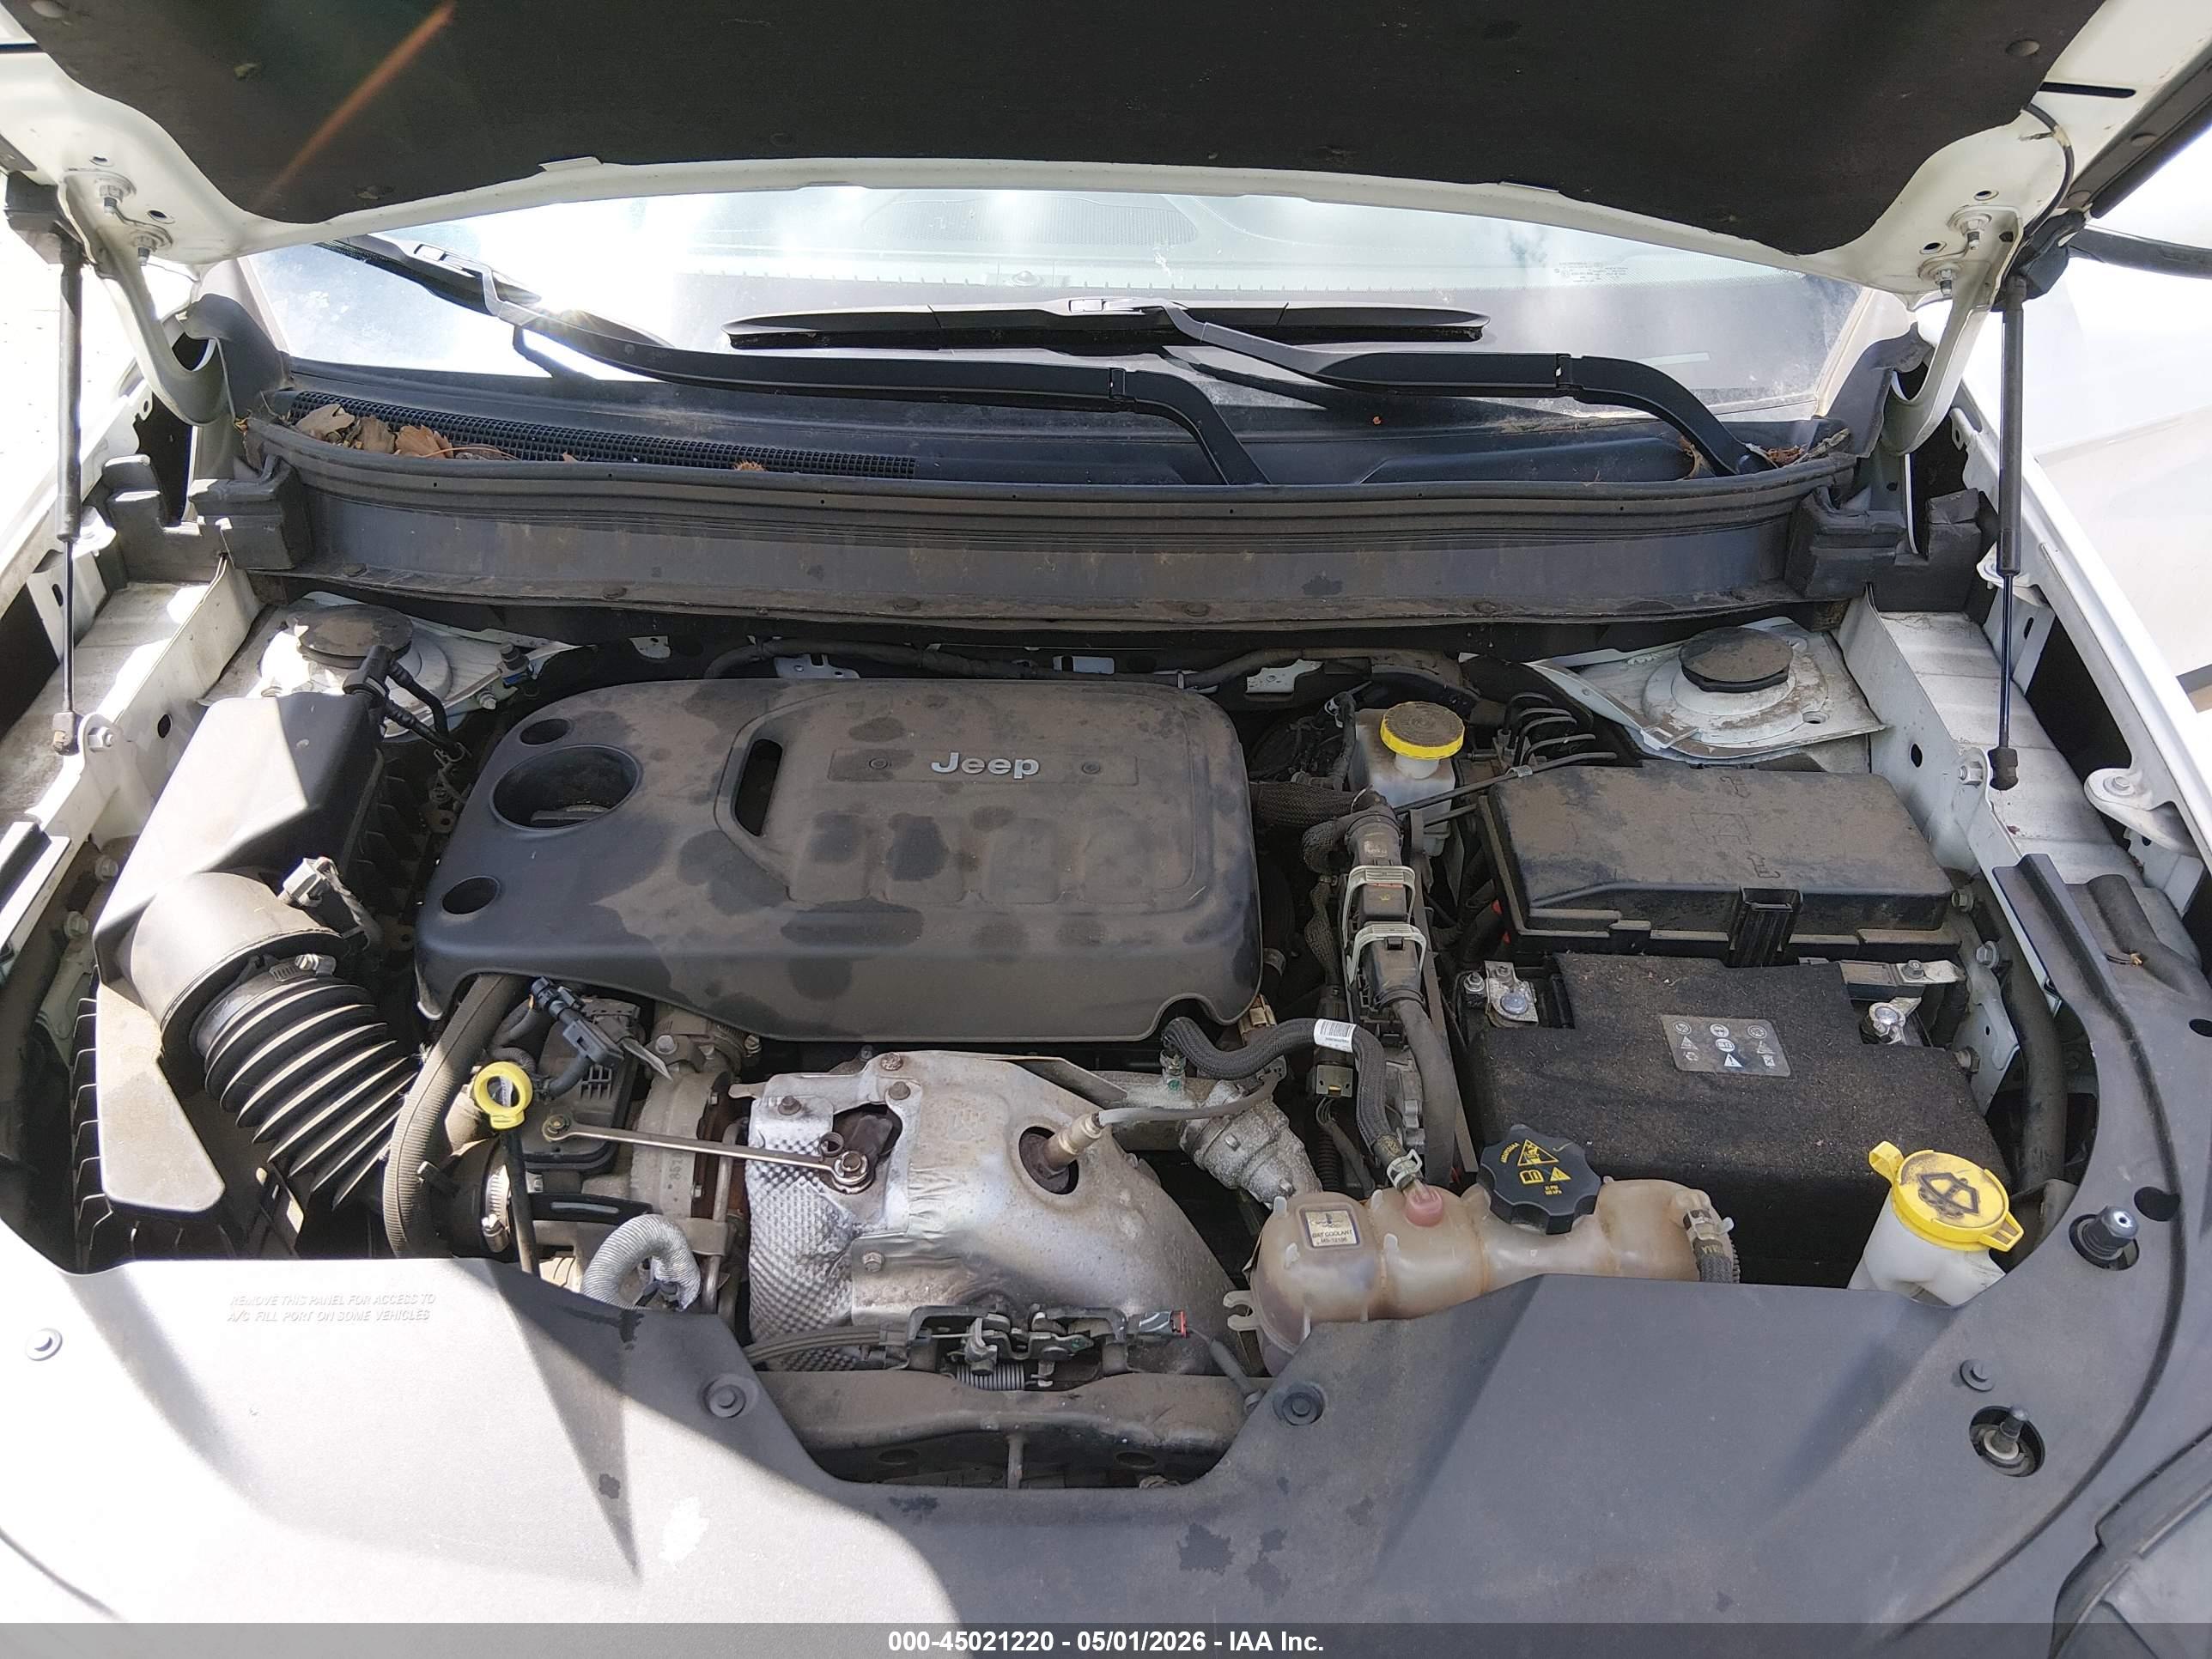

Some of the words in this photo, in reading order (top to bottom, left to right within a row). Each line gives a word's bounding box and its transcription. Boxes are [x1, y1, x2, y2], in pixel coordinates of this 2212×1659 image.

[931, 751, 1040, 780] Jeep
[1325, 1229, 1353, 1237] COOLANT
[229, 1295, 277, 1306] REMOVE
[277, 1295, 308, 1306] THIS
[308, 1295, 344, 1306] PANEL
[347, 1295, 371, 1305] FOR
[373, 1294, 418, 1305] ACCESS
[416, 1293, 437, 1304] TO
[226, 1310, 250, 1322] A/C
[254, 1311, 278, 1322] FILL
[282, 1311, 314, 1322] PORT
[317, 1311, 335, 1322] ON
[337, 1310, 372, 1322] SOME
[375, 1310, 431, 1321] VEHICLES
